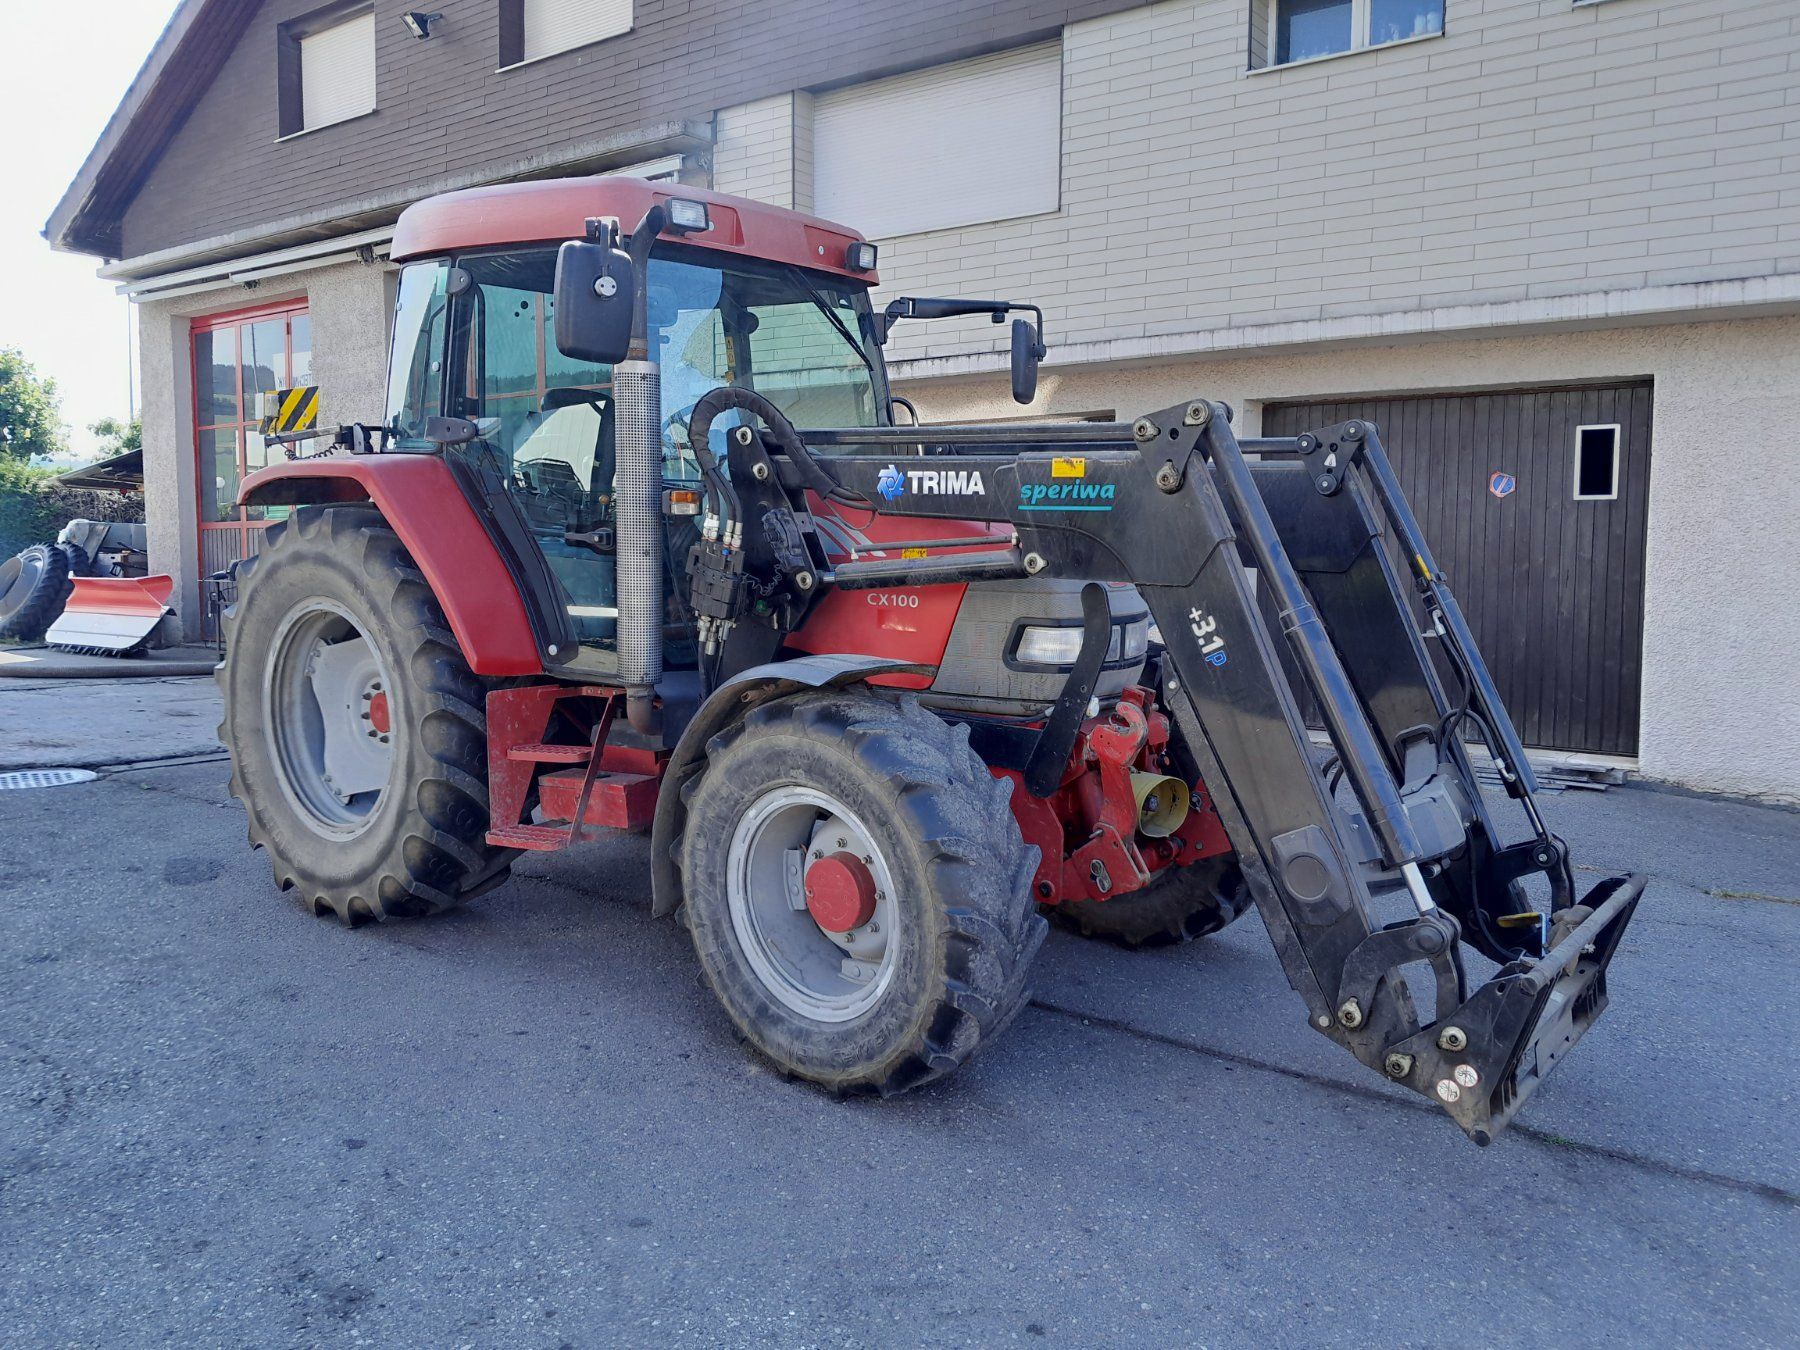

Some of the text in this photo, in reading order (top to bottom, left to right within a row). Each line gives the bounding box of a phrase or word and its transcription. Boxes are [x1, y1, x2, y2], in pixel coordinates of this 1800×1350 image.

[907, 471, 986, 496] TRIMA
[1020, 479, 1116, 504] speriwa
[867, 593, 919, 608] CX100
